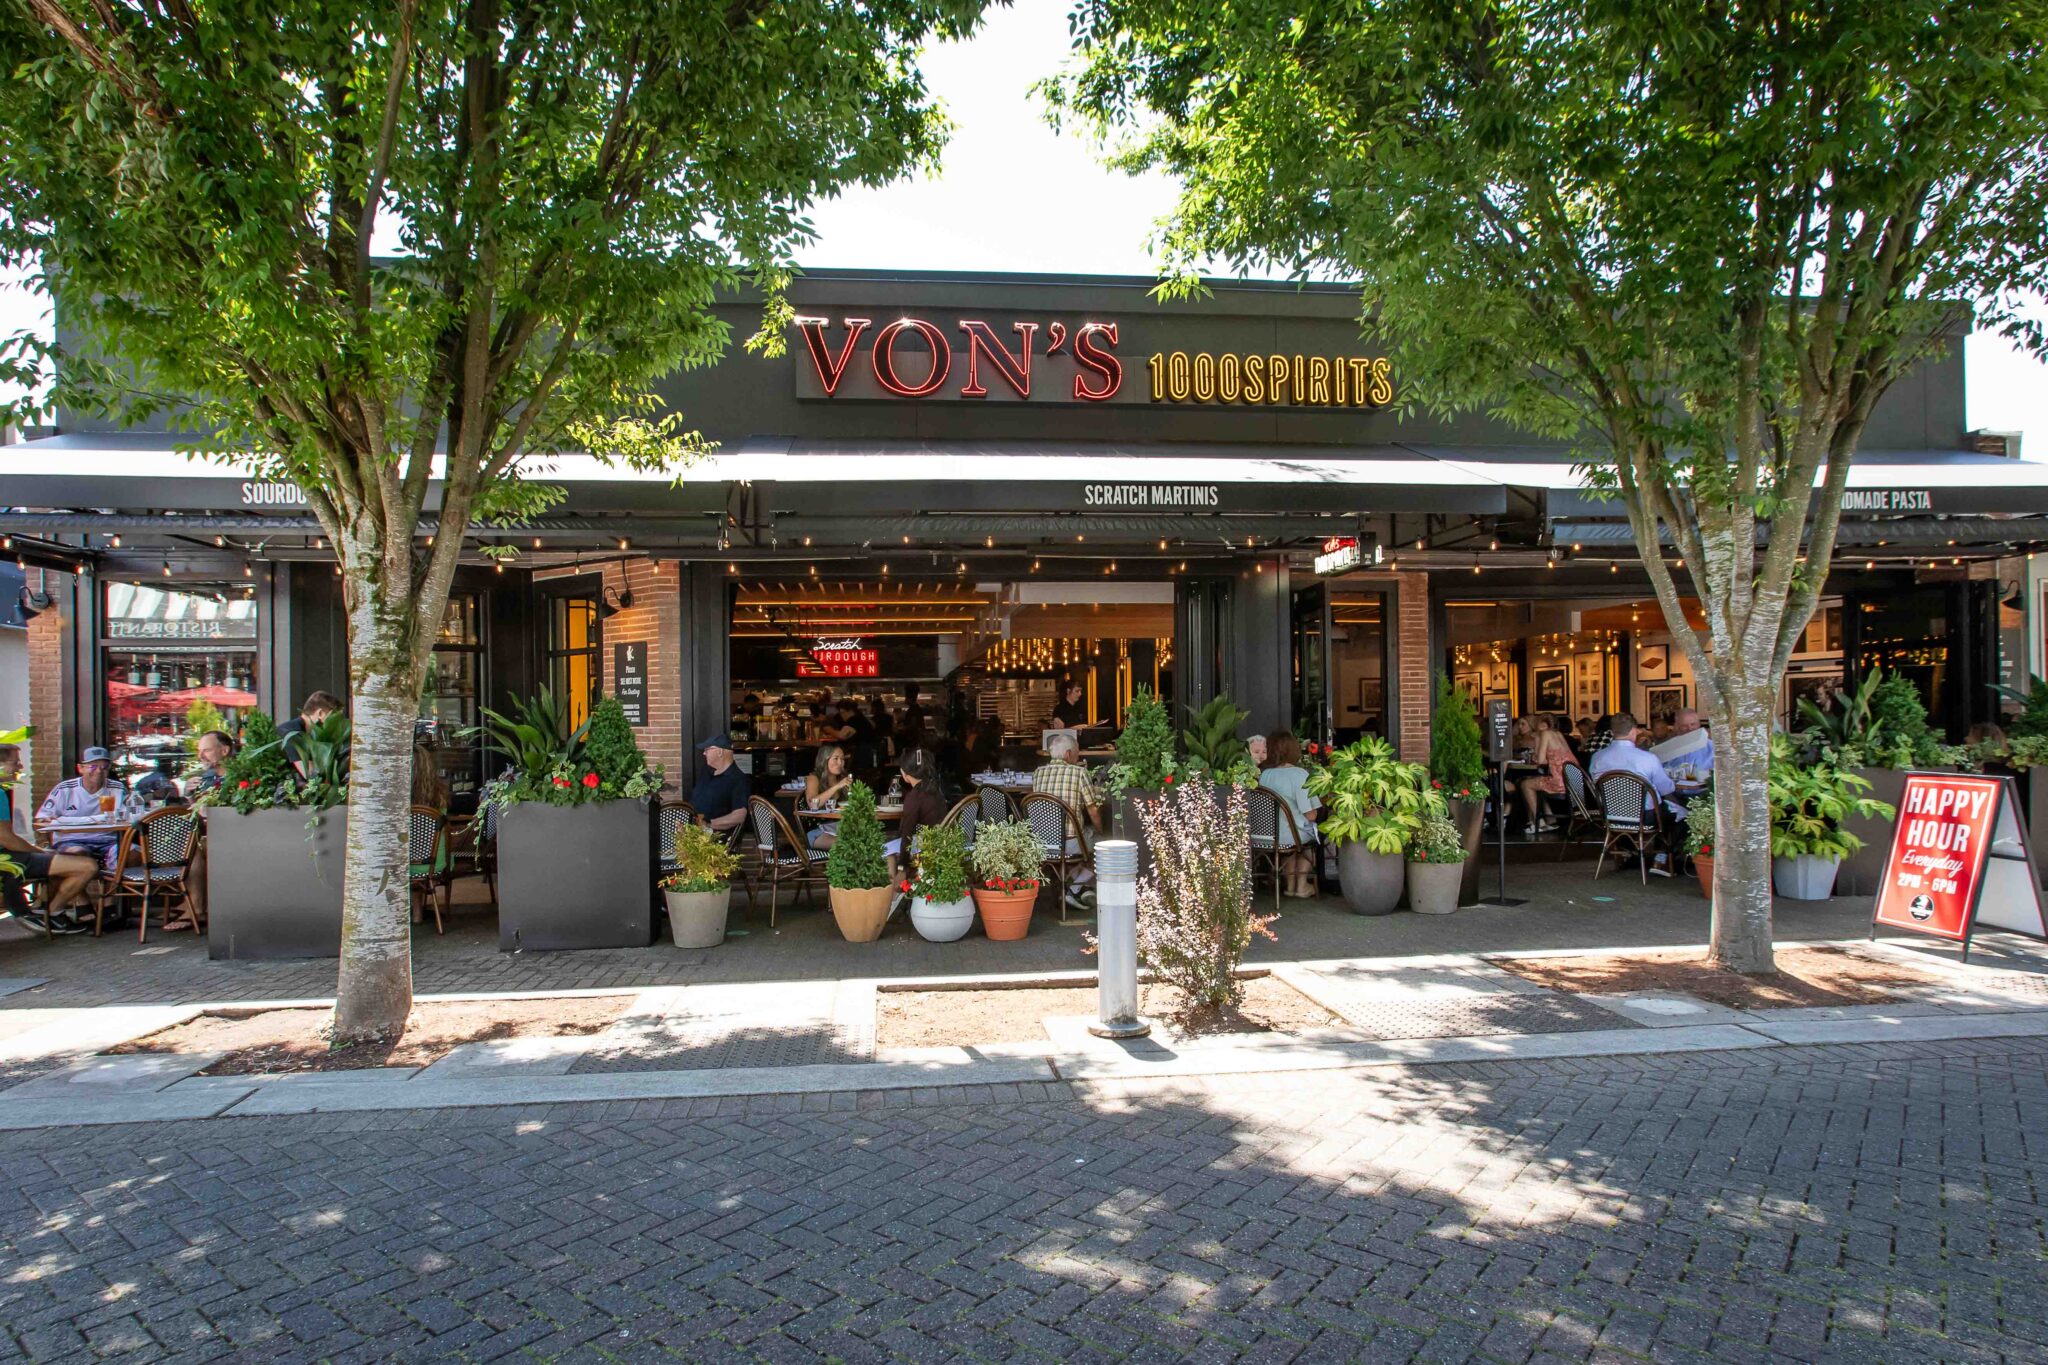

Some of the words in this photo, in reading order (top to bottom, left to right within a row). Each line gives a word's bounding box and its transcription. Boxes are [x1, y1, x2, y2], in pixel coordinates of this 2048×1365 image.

[794, 315, 1122, 401] VON'S
[1148, 351, 1392, 405] 1000SPIRITS
[242, 482, 308, 505] SOURDO
[1084, 484, 1148, 505] SCRATCH
[1151, 485, 1219, 506] MARTINIS
[1841, 490, 1889, 509] DMADE
[1892, 490, 1931, 509] PASTA
[813, 637, 863, 651] Scratch
[809, 651, 875, 661] URDOUGH
[801, 665, 875, 674] KCHEN
[1907, 786, 1988, 819] HAPPY
[1905, 819, 1971, 852] HOUR
[1901, 850, 1964, 878] Everyday
[1897, 872, 1922, 889] 2PM
[1931, 876, 1958, 895] 6PM
